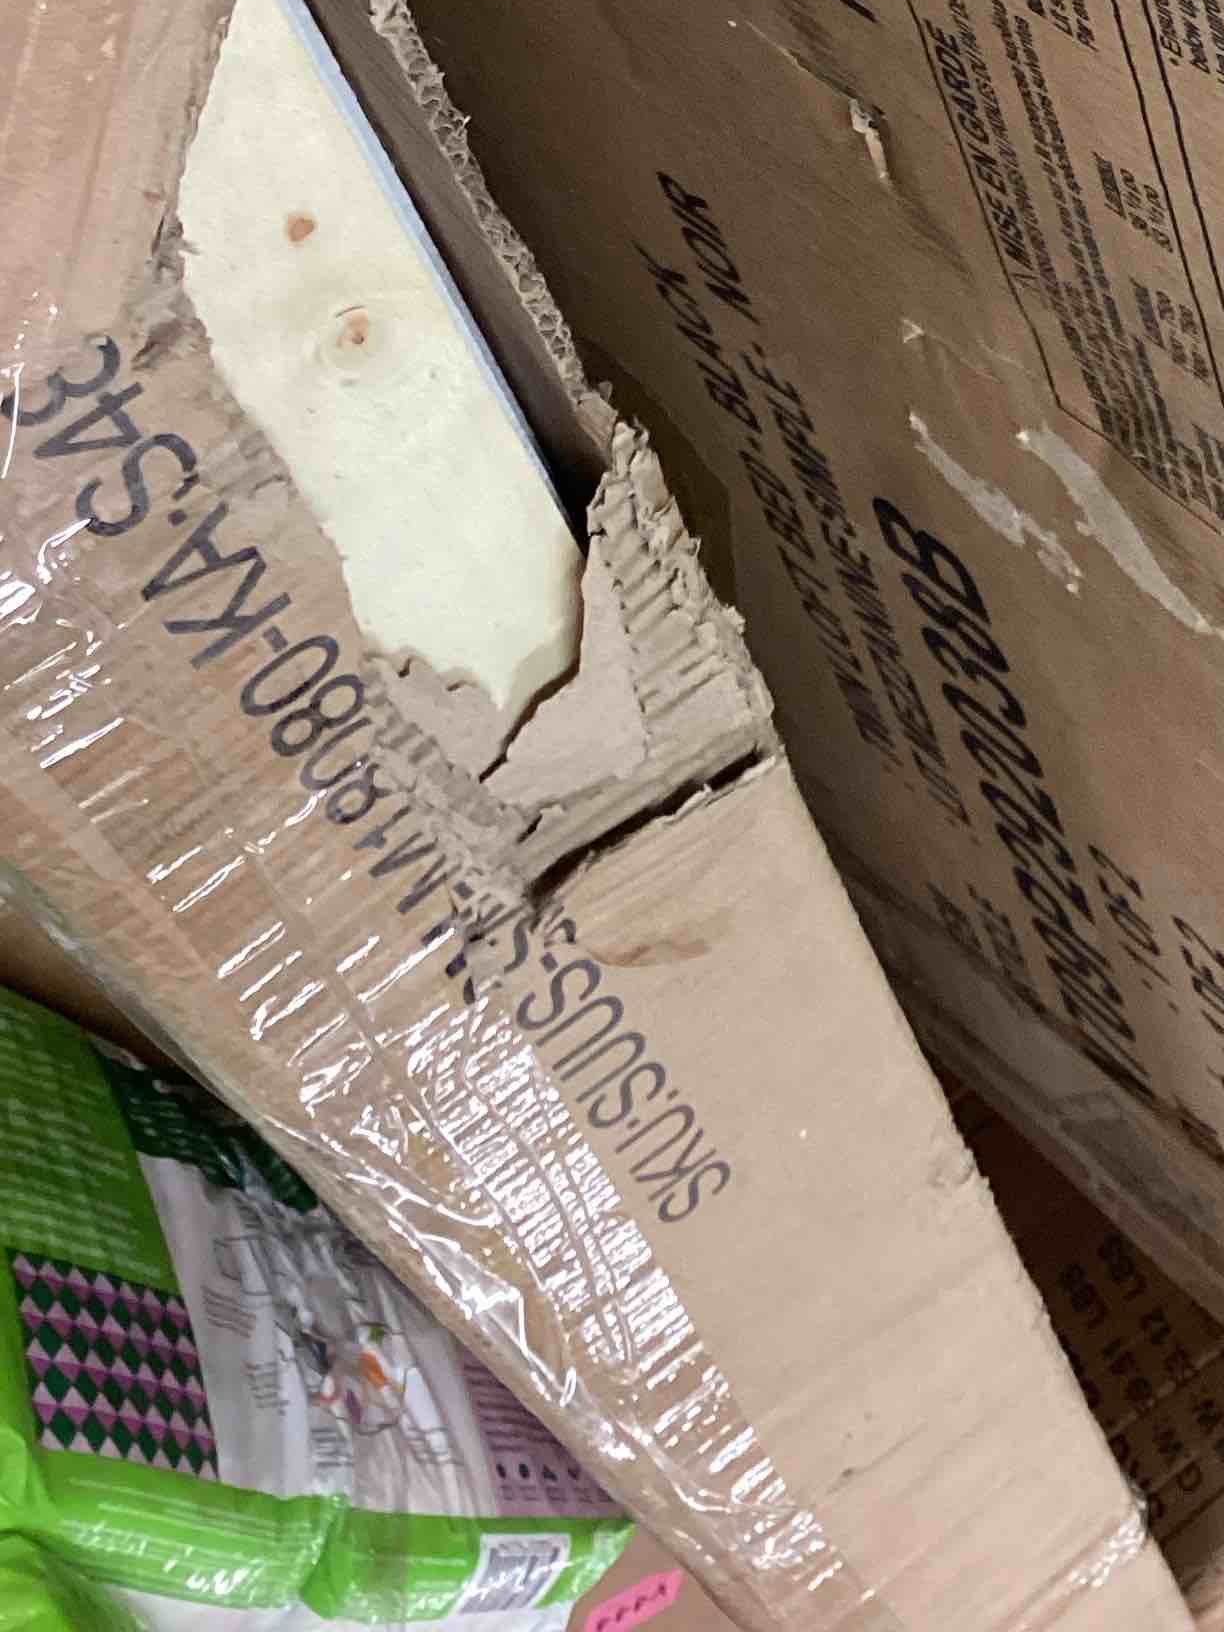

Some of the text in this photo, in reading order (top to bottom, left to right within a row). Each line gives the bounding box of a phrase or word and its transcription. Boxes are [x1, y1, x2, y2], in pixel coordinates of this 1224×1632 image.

[920, 9, 994, 153] GARDE
[1177, 15, 1210, 74] below
[653, 169, 759, 323] NOIR
[984, 186, 1036, 277] MISE
[631, 239, 763, 434] BLACK
[742, 353, 858, 535] SIMPLE
[736, 453, 817, 560] BED
[781, 553, 863, 671] LOFT
[1087, 842, 1144, 899] 2
[1096, 874, 1161, 957] OF
